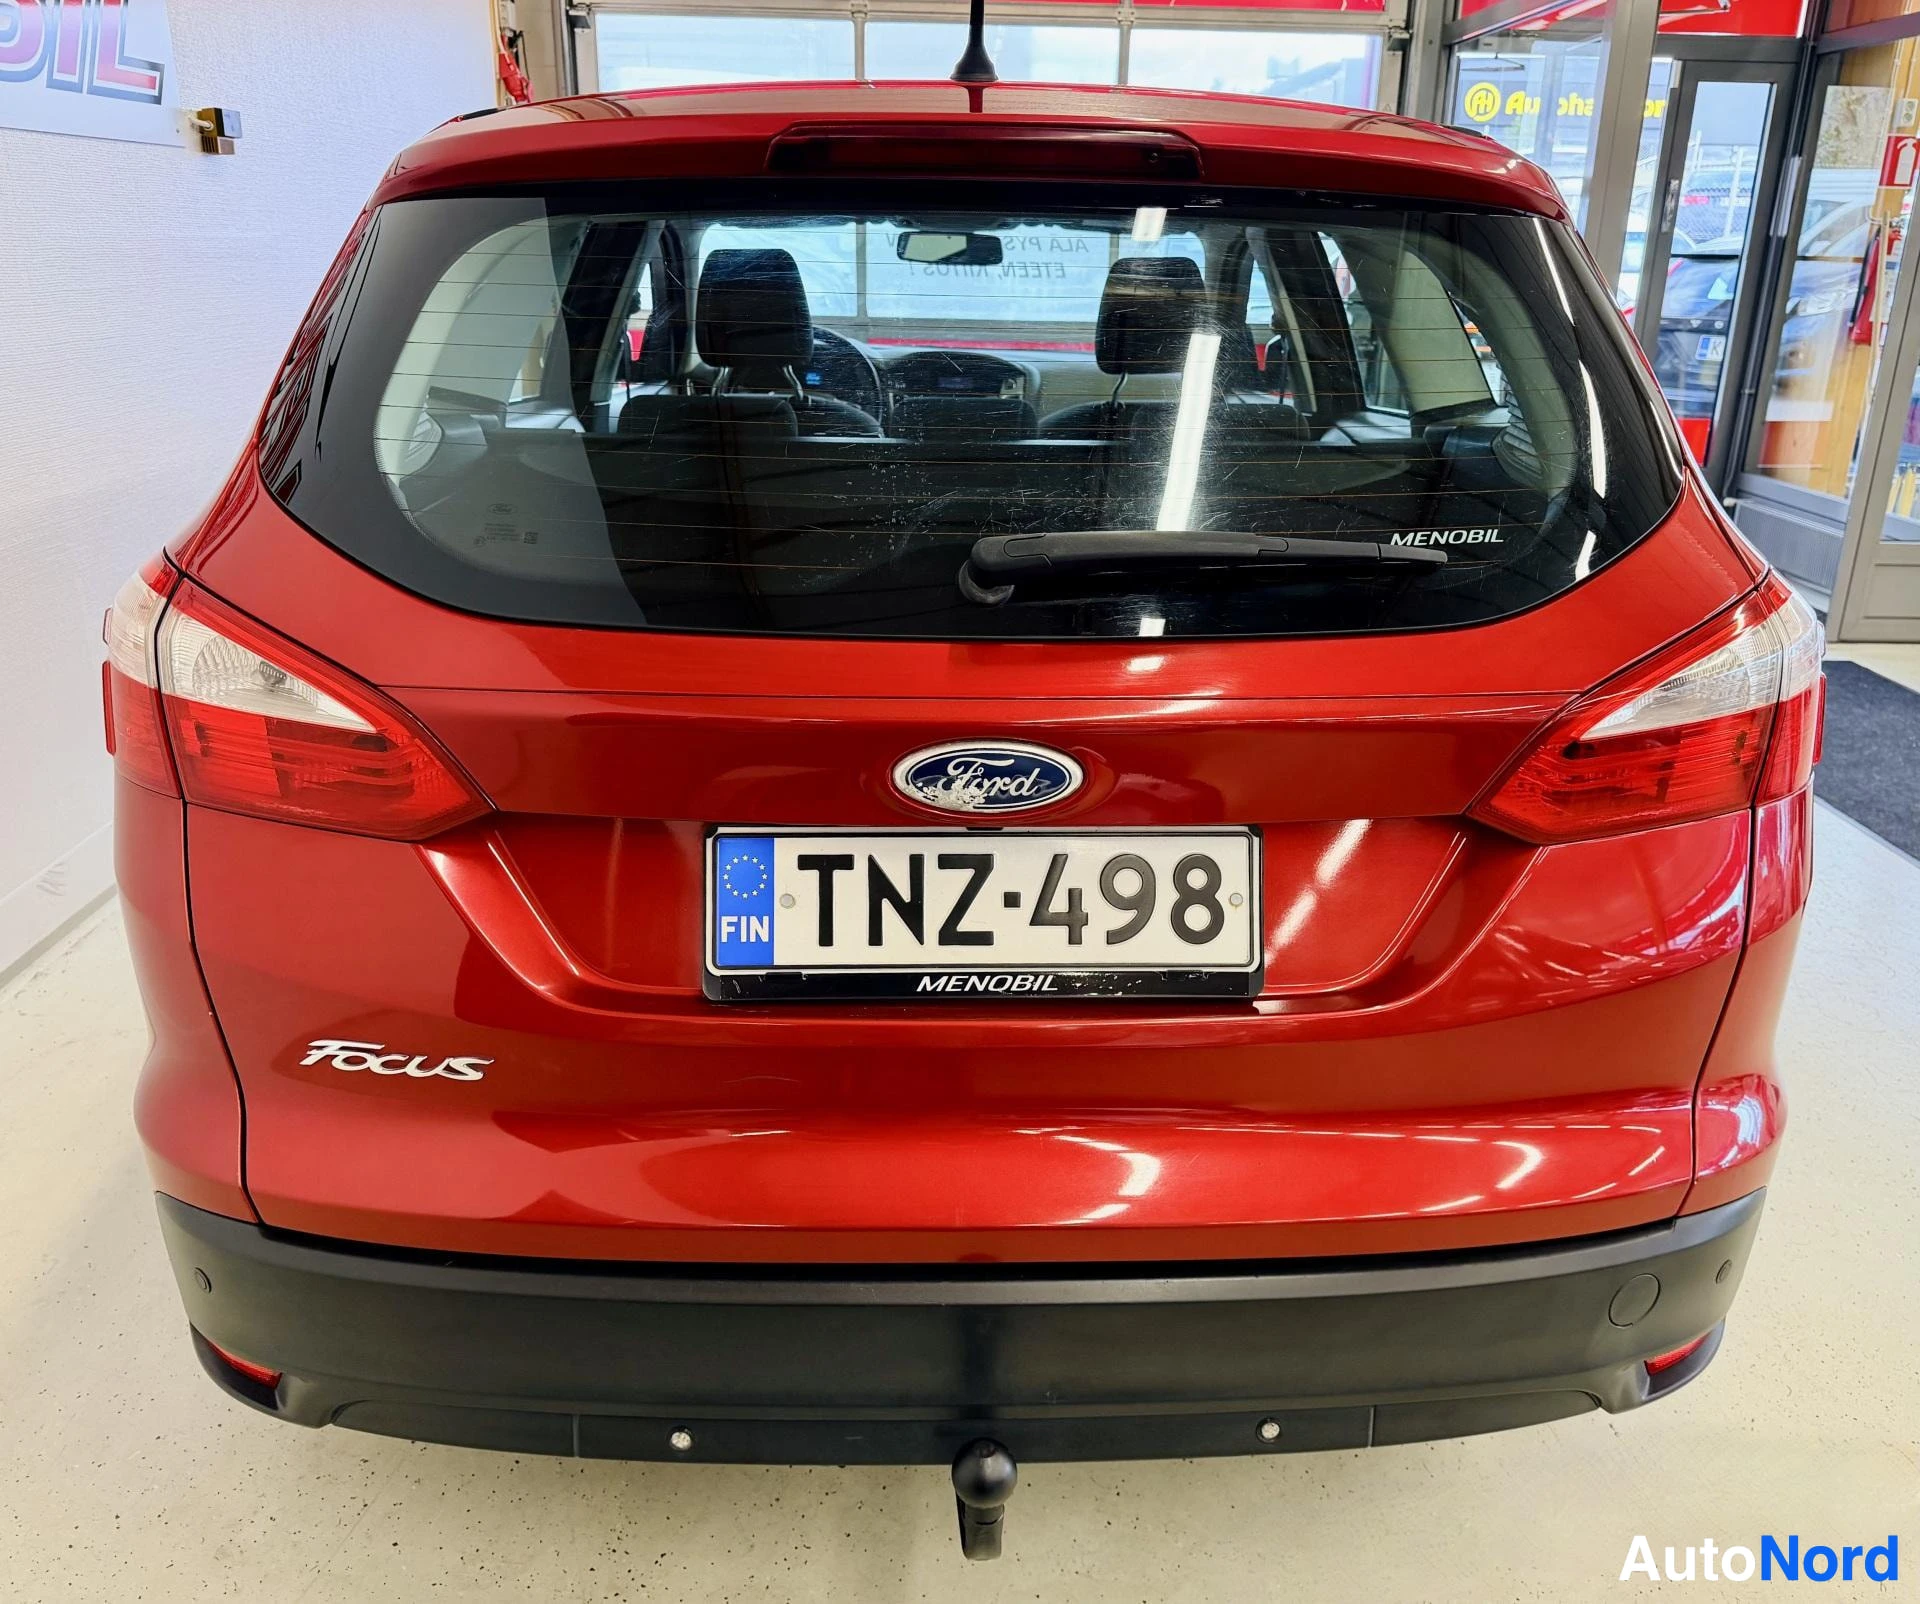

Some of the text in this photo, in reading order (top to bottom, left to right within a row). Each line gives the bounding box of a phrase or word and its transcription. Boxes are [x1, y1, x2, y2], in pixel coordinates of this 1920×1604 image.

[1390, 529, 1504, 546] MENOBIL
[936, 757, 1041, 797] Ford
[797, 853, 1225, 947] TNZ-498
[720, 915, 770, 943] FIN
[916, 975, 1058, 992] MENOBIL
